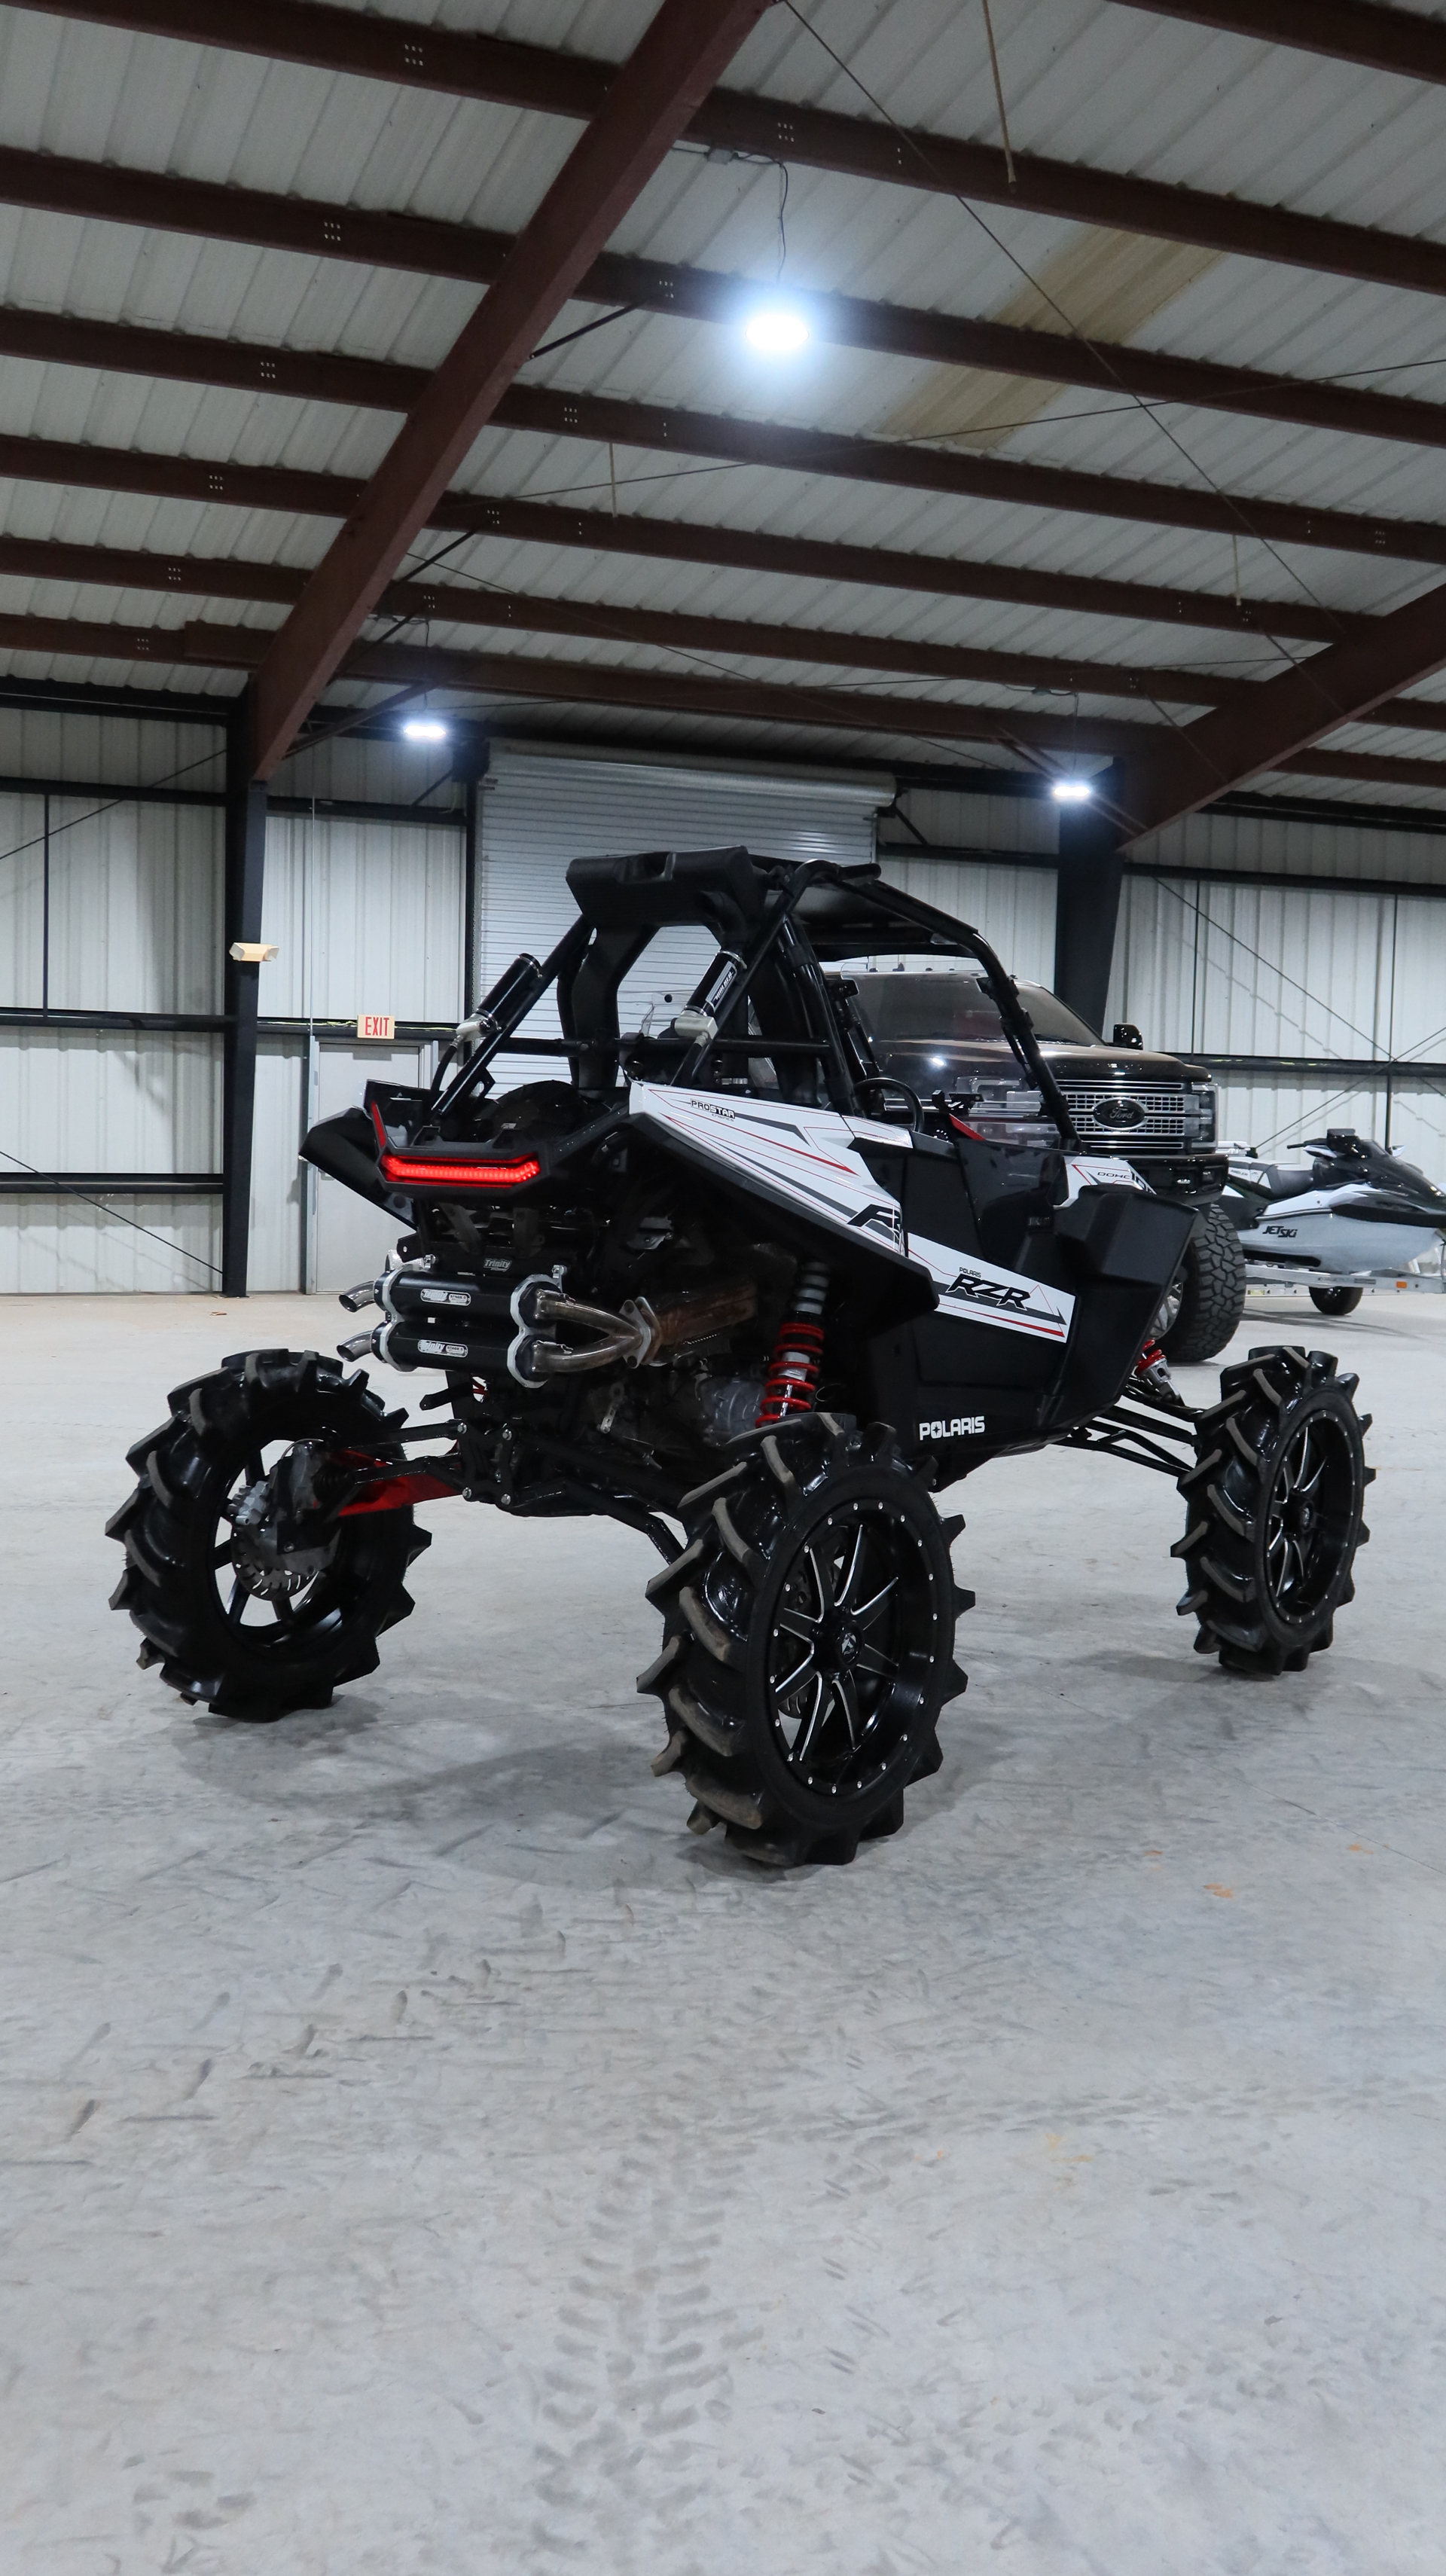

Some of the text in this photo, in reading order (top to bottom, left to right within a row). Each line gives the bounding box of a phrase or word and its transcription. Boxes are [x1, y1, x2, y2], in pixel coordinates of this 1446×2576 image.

[365, 1017, 389, 1036] EXIT
[691, 1100, 735, 1119] PROSTAR
[1109, 1107, 1134, 1119] Ford
[1262, 1225, 1284, 1235] JET
[484, 1259, 511, 1268] Trinity
[959, 1267, 981, 1278] POLARIS
[946, 1273, 1031, 1311] RZR
[920, 1416, 985, 1440] POLARIS
